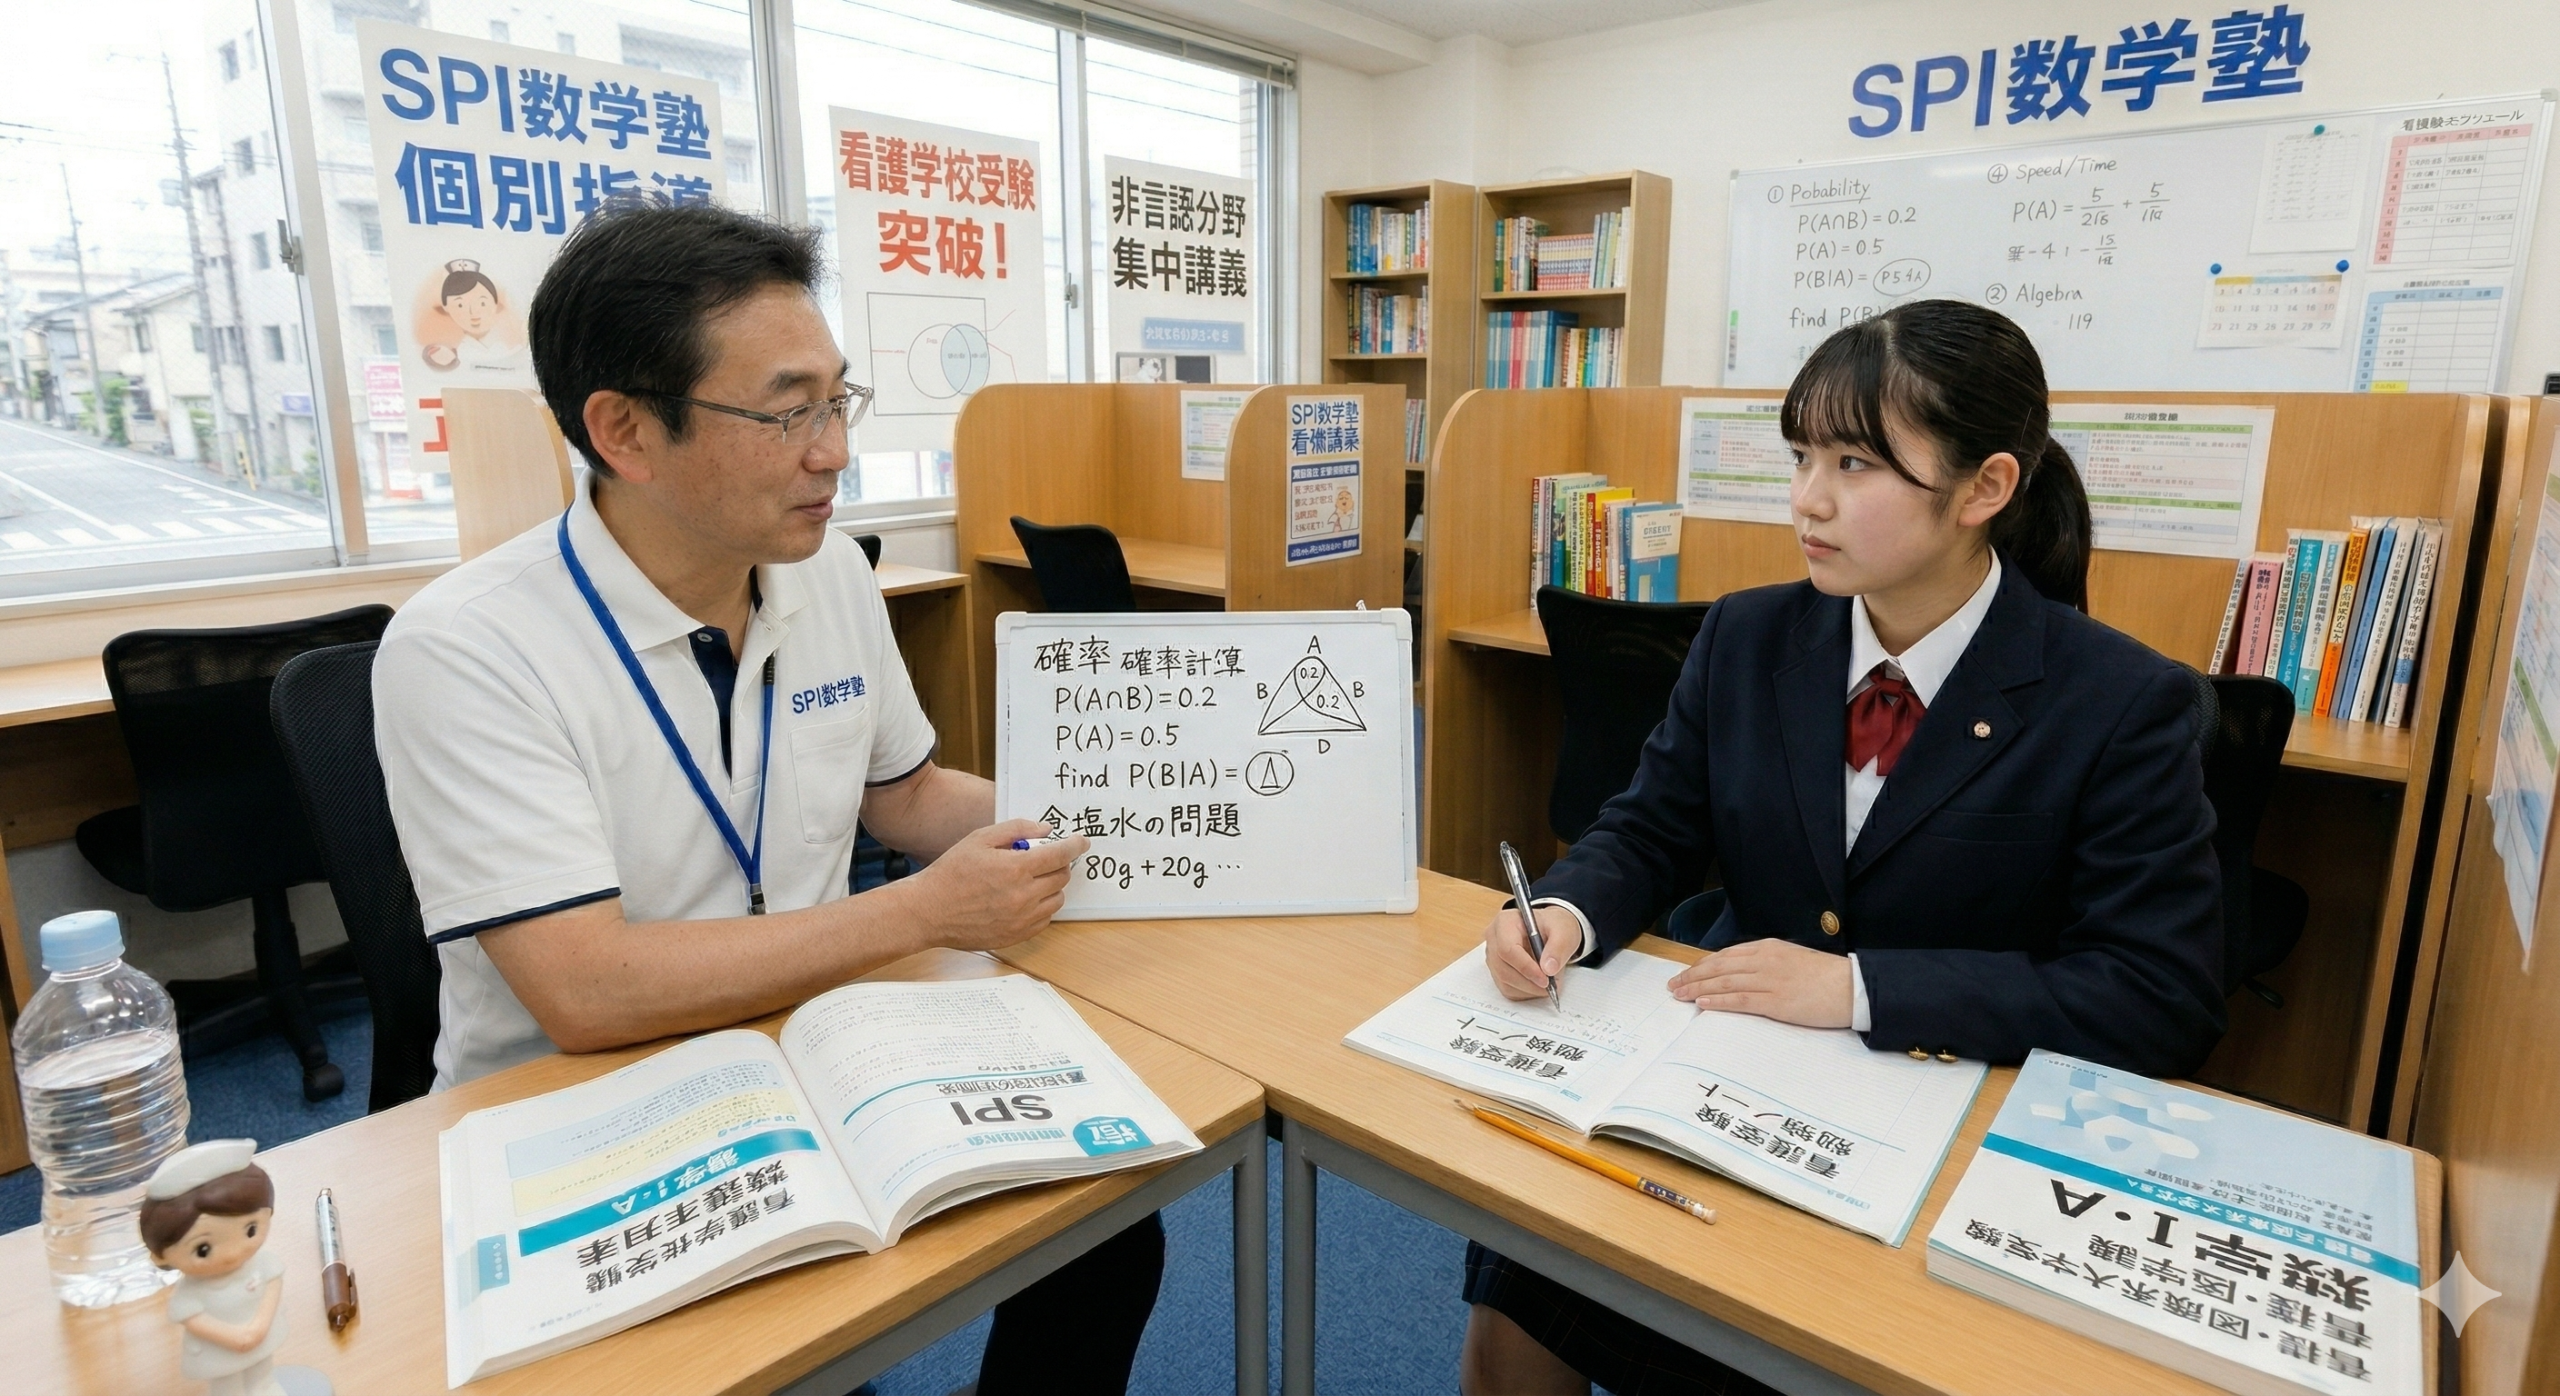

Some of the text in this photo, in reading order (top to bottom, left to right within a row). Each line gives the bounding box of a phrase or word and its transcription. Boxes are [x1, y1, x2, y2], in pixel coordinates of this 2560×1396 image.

[1848, 4, 2312, 138] SPI数学塾
[379, 48, 712, 160] SPI数学塾
[839, 130, 1037, 211] 看護学校受験
[1790, 178, 1871, 204] Pobability
[877, 209, 1007, 280] 突破！
[1113, 236, 1248, 297] 集中講義
[2015, 283, 2083, 308] Algebra
[1789, 306, 1827, 329] find
[1291, 402, 1359, 425] SPI数学塾
[1034, 635, 1111, 674] 確率
[1307, 635, 1321, 654] A
[792, 675, 866, 714] SPI数学塾
[1257, 682, 1268, 699] B
[1316, 694, 1340, 709] 0.2
[1353, 681, 1365, 698] B
[1318, 738, 1331, 754] D
[1054, 761, 1109, 790] find
[950, 1094, 1053, 1126] SPI
